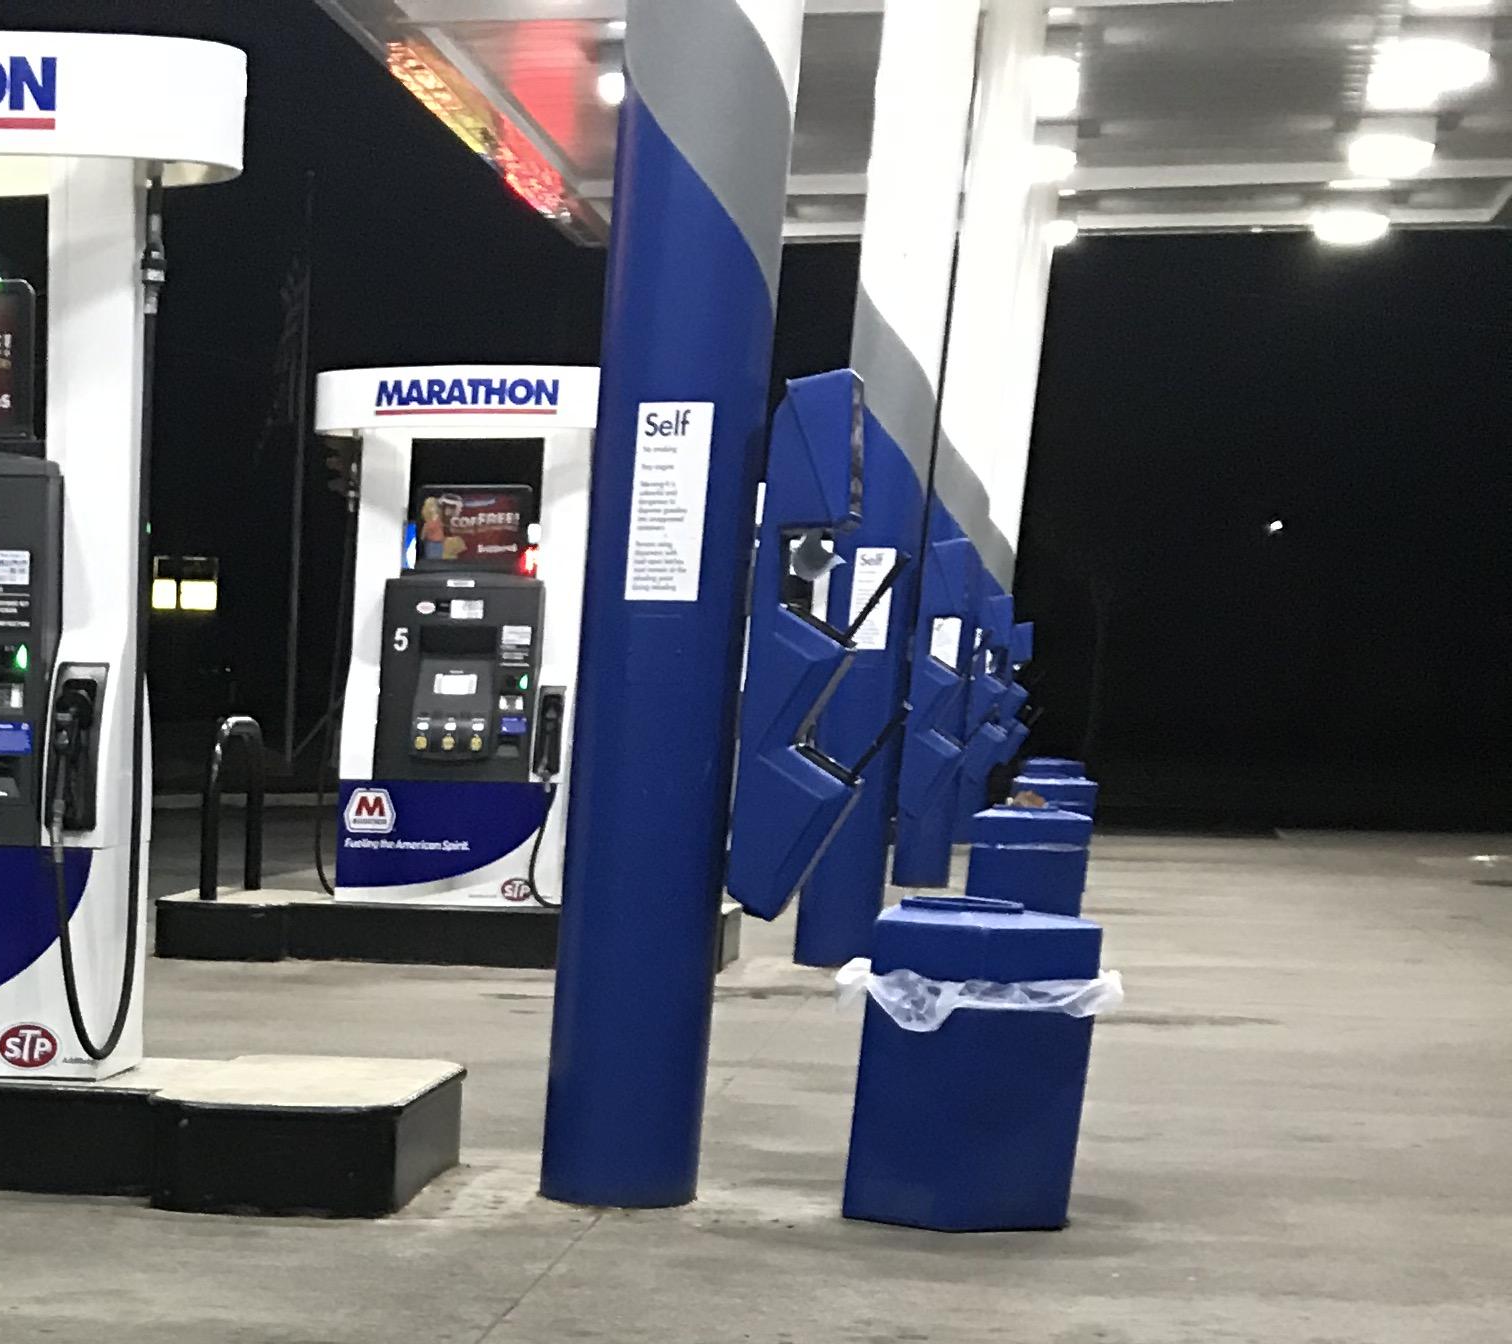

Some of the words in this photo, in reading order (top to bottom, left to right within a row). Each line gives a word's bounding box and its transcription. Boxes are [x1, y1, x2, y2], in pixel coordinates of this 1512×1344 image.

[376, 379, 560, 407] MARATHON
[644, 409, 691, 437] Self
[393, 628, 409, 651] 5
[355, 796, 385, 816] M
[504, 880, 531, 899] STP
[4, 1029, 53, 1064] STP
